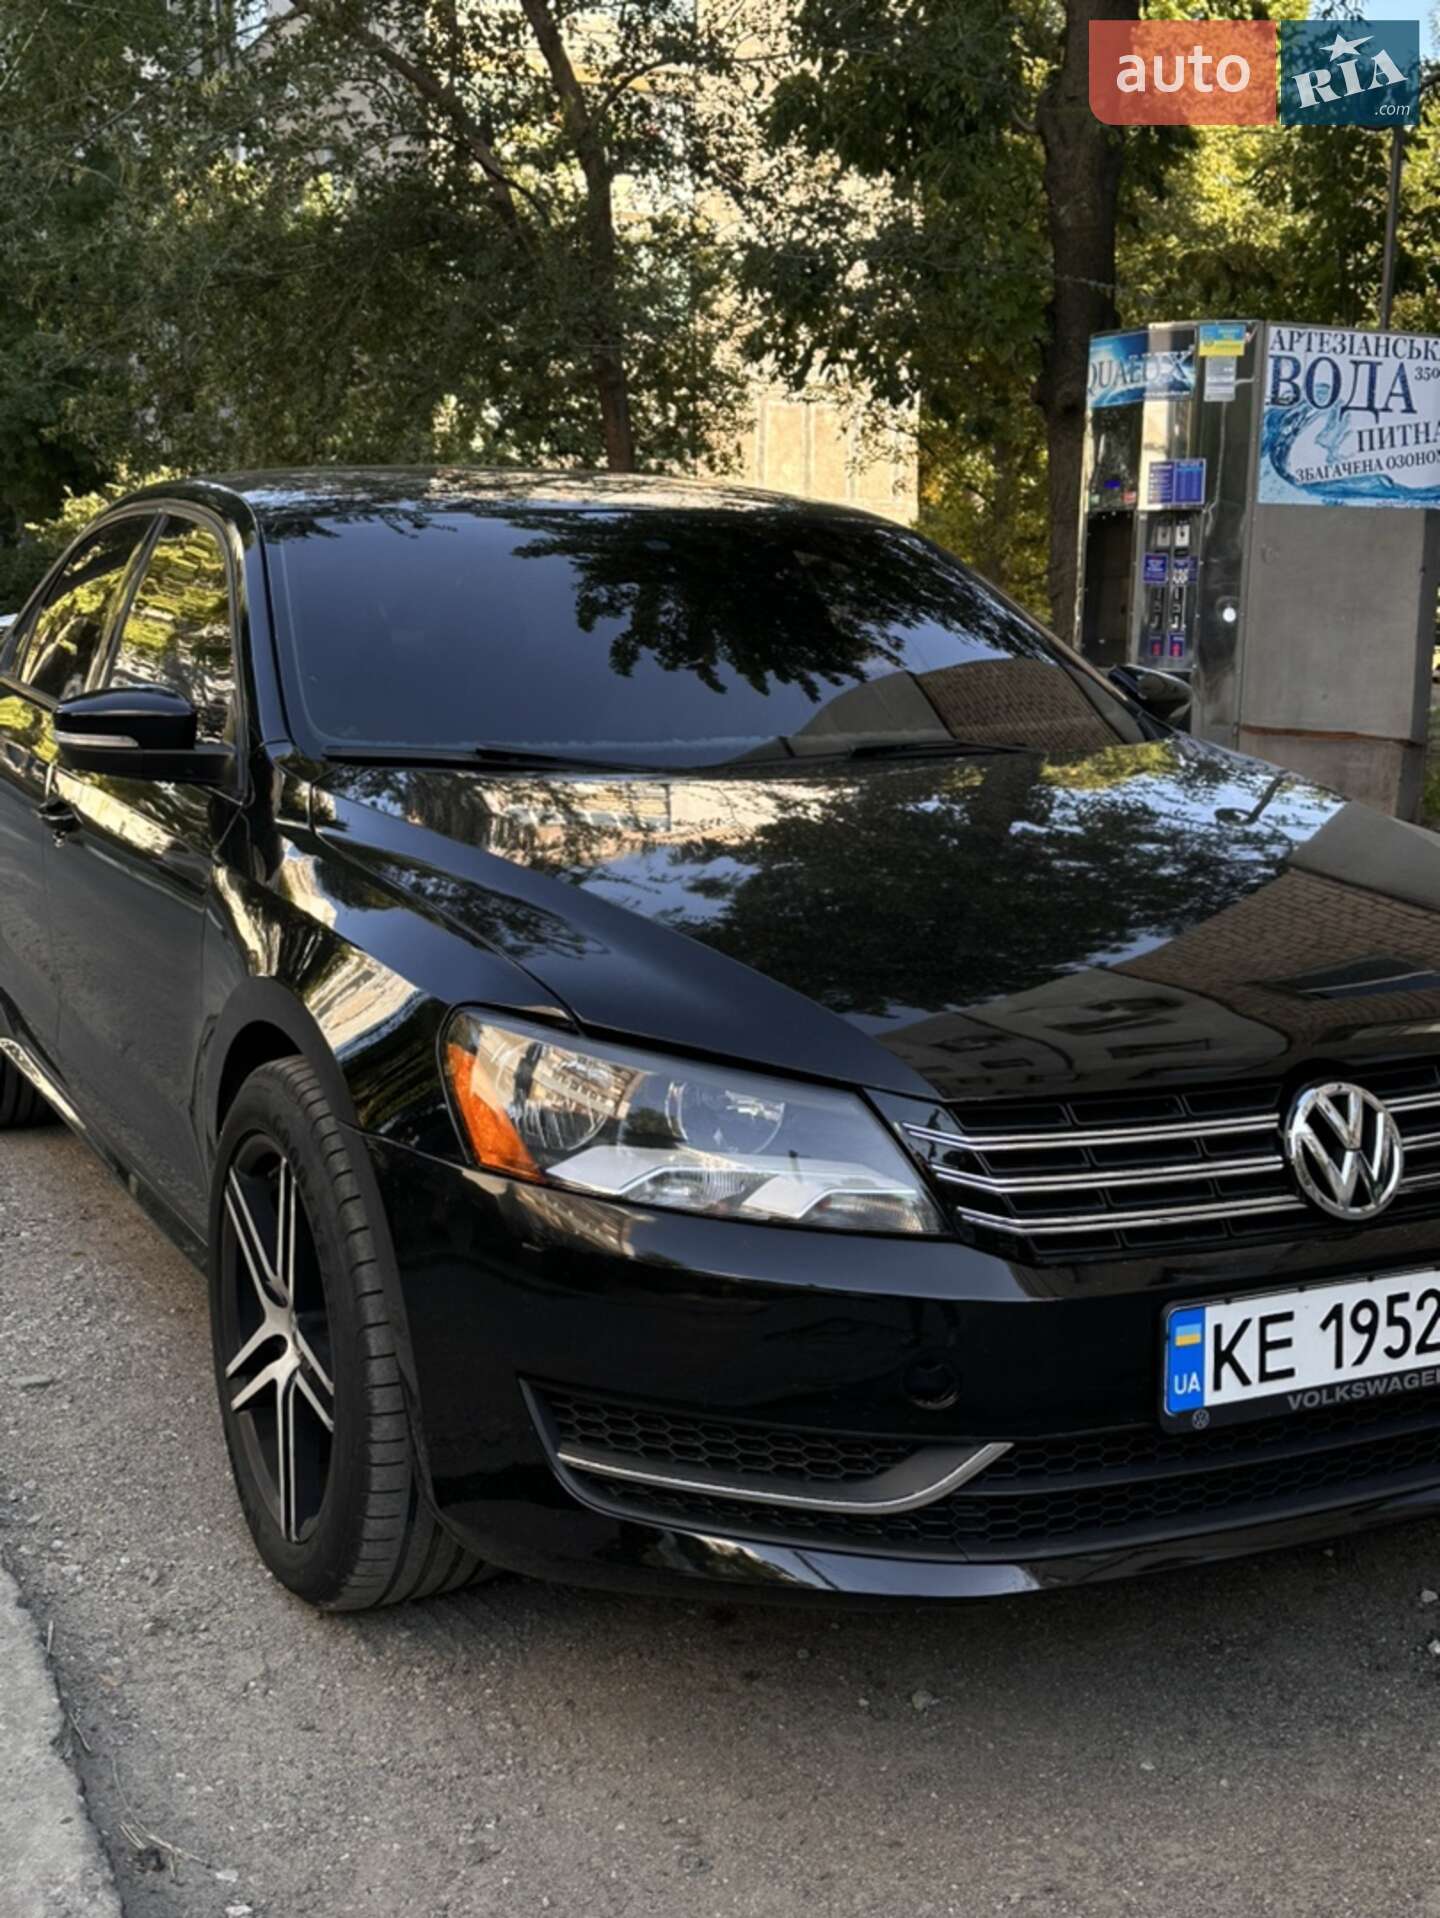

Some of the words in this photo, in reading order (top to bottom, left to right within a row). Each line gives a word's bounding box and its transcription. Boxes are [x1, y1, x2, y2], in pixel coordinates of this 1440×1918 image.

[1269, 328, 1440, 361] АРТЕЗІАНСЬК
[1269, 354, 1418, 424] ВОДА
[1295, 458, 1384, 483] ЗБАГАЧЕНА
[1213, 1310, 1296, 1392] KE
[1319, 1287, 1440, 1369] 1952
[1174, 1371, 1201, 1395] UA
[1287, 1366, 1440, 1411] VOLKSWAGE
